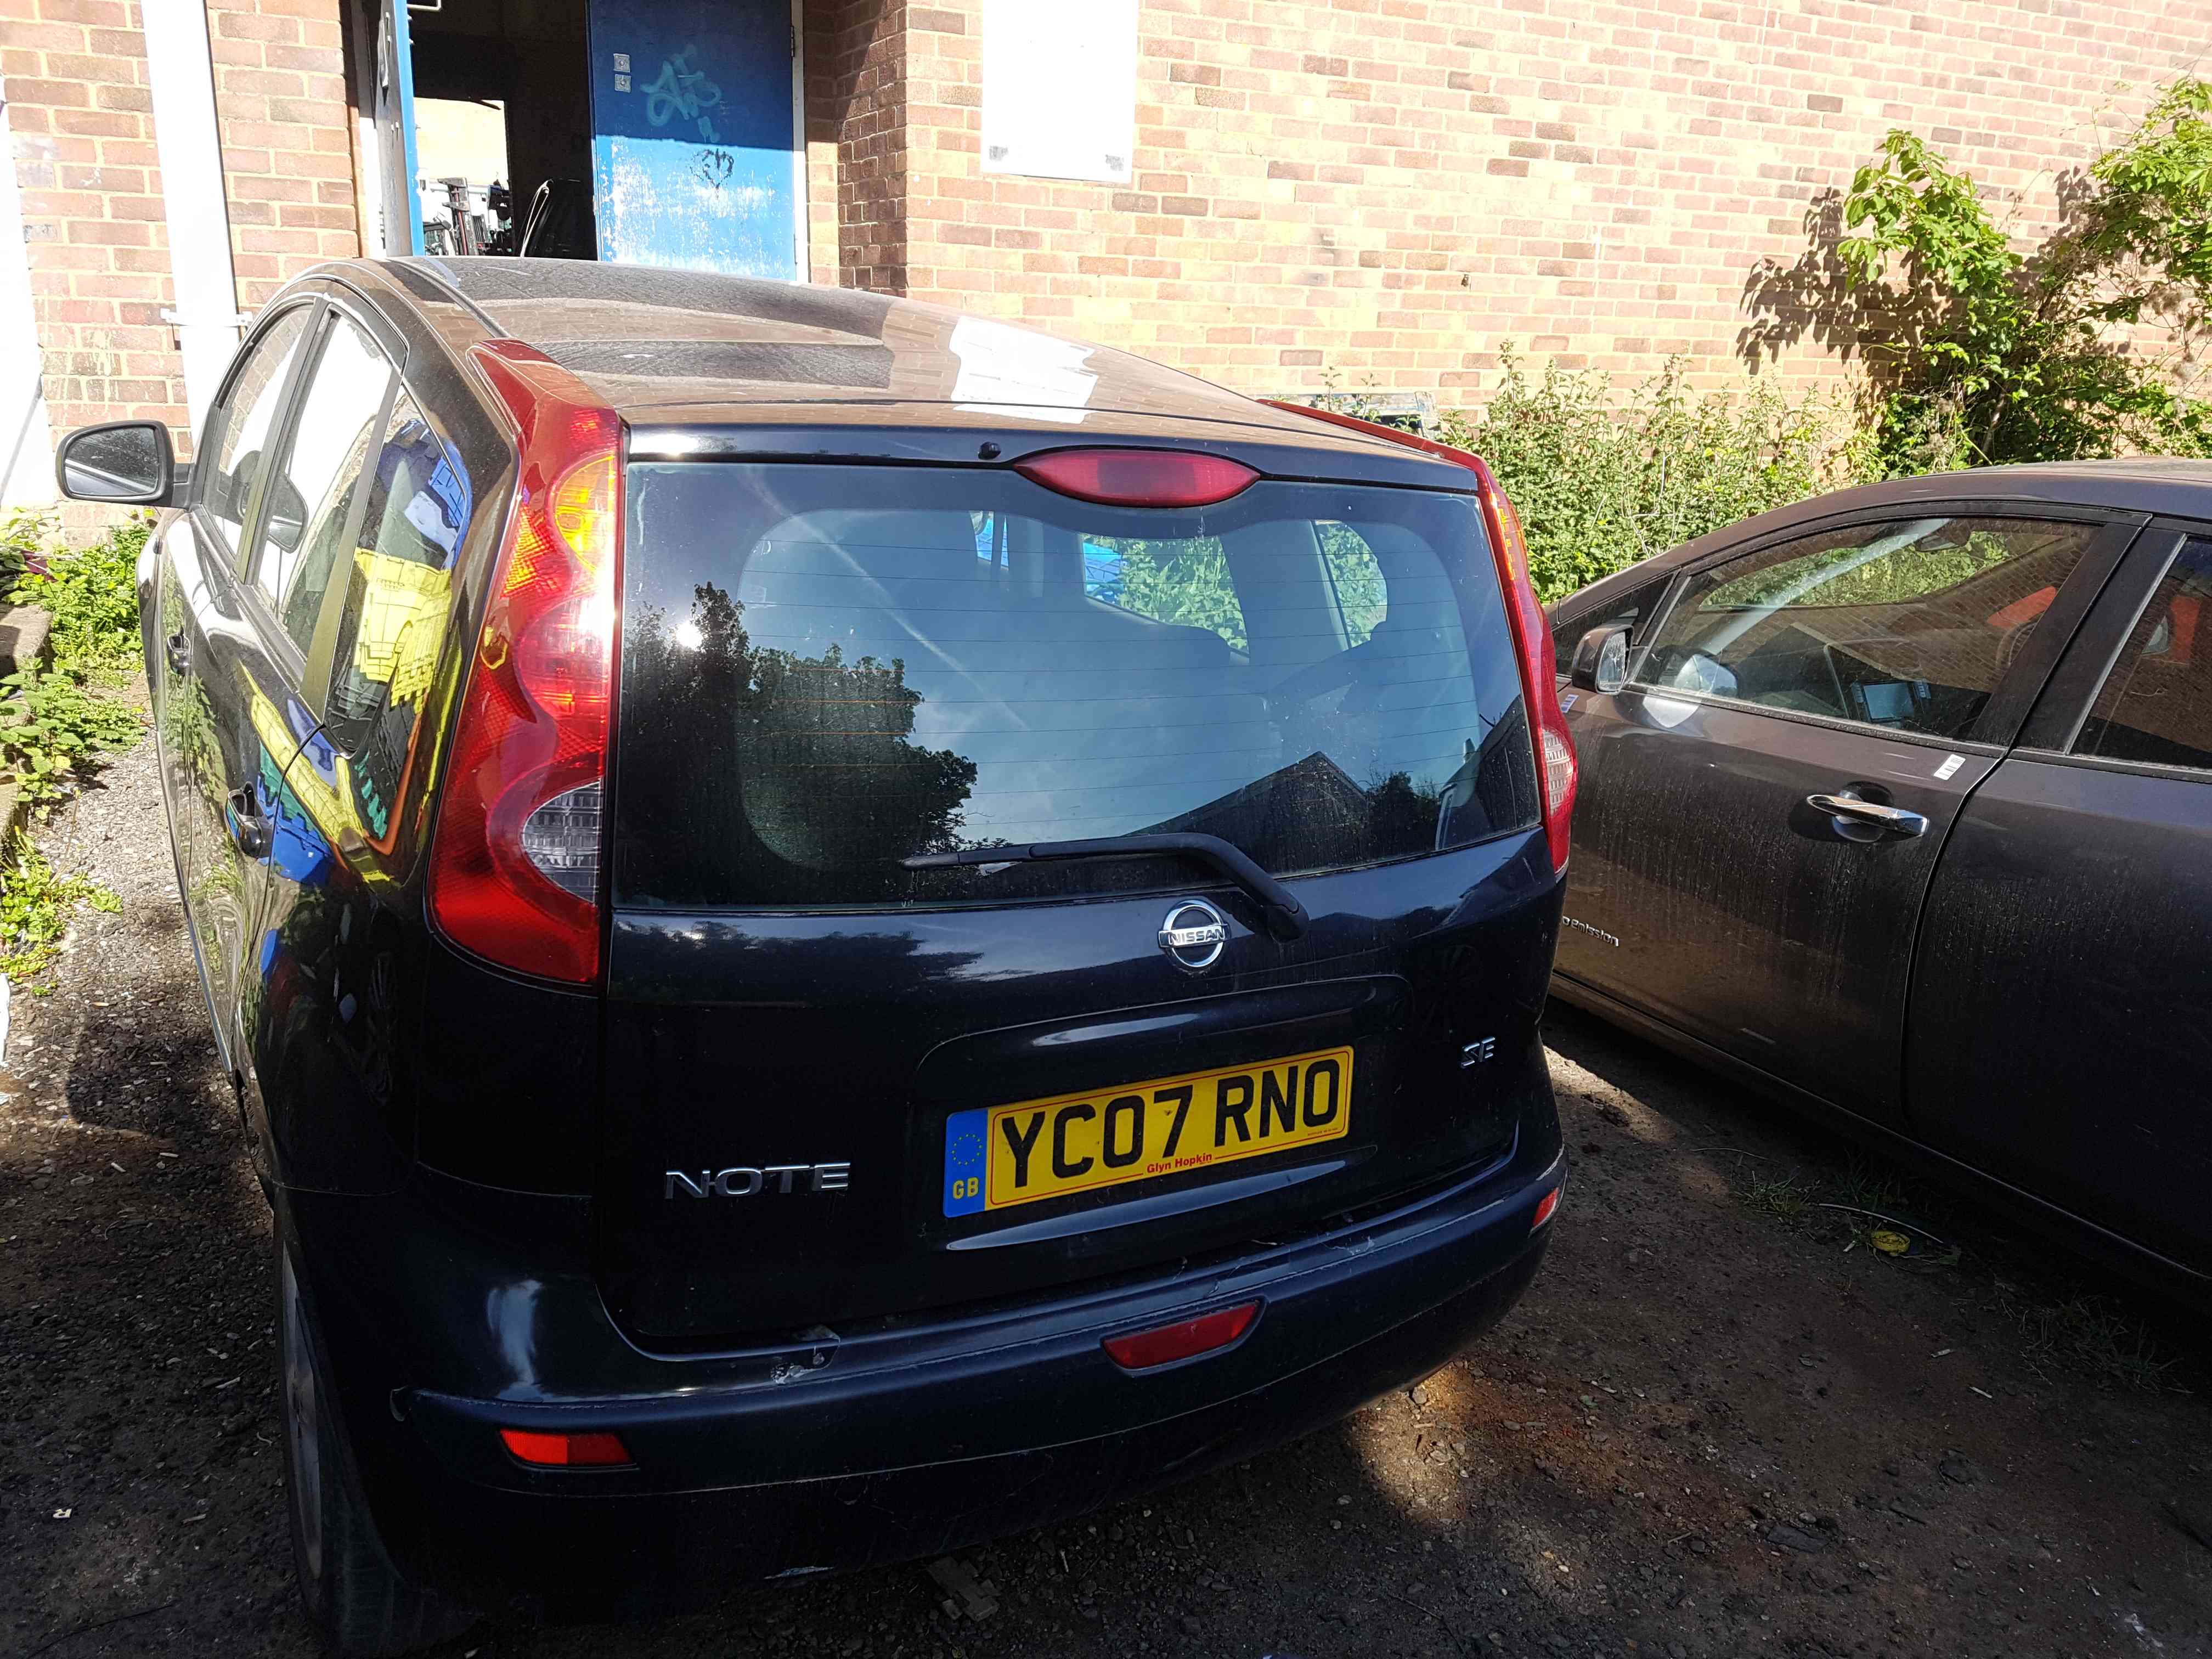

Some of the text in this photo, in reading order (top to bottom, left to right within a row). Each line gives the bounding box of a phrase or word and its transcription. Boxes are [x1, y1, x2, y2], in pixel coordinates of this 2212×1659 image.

[1169, 929, 1224, 944] NISSAN
[1571, 918, 1619, 947] emission
[1461, 1037, 1496, 1068] SE
[1001, 1058, 1340, 1188] YC07 RNO
[1147, 1153, 1212, 1173] Glyn Hopkin
[665, 1163, 851, 1200] NOTE
[952, 1177, 979, 1199] GB
